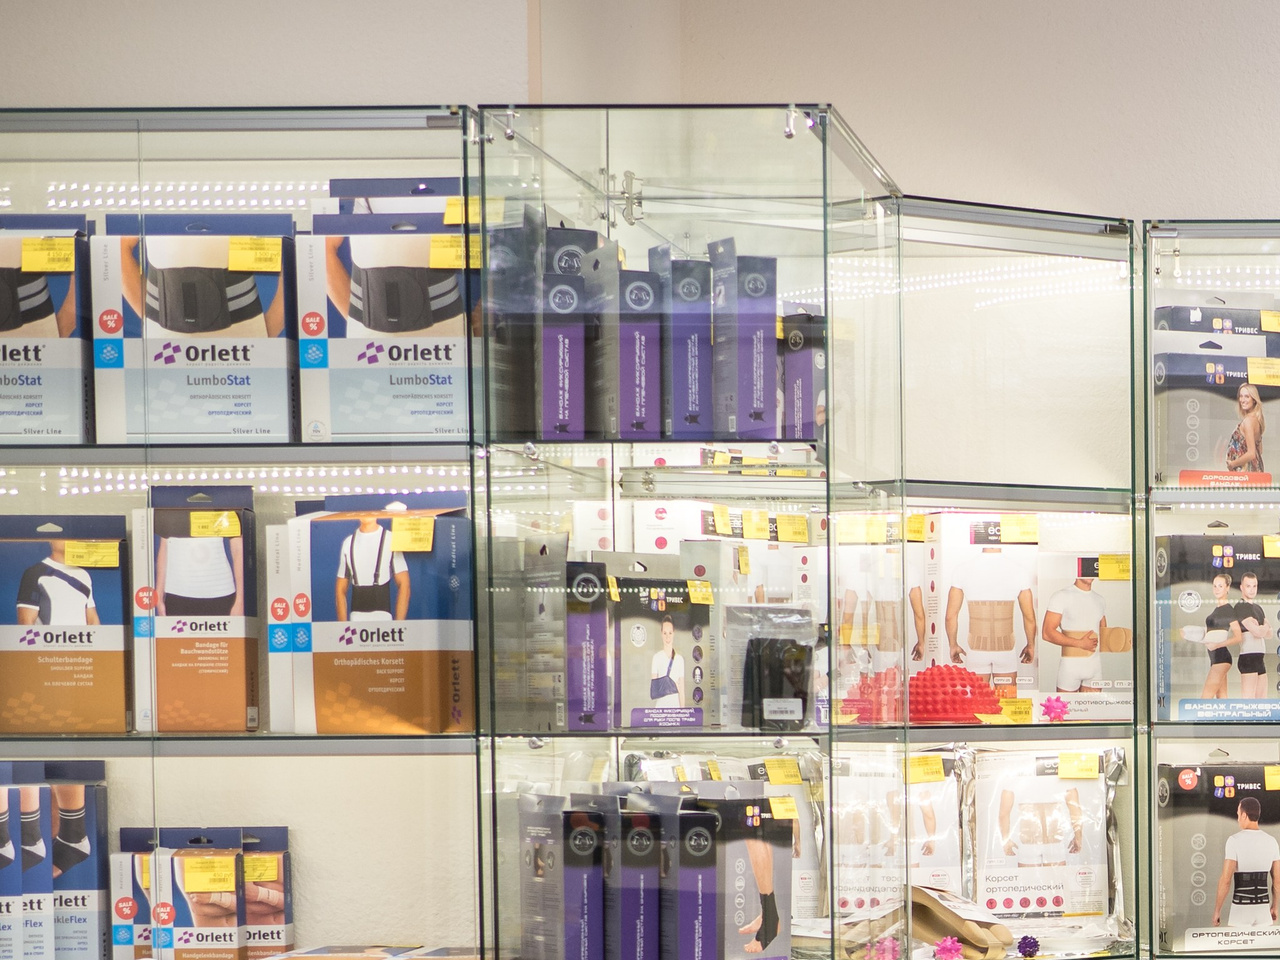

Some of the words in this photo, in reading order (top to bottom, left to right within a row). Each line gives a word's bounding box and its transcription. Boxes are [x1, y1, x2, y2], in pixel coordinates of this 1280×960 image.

[0, 344, 42, 362] lett
[185, 344, 251, 362] Orlett
[388, 344, 453, 361] Orlett
[186, 374, 252, 386] LumboStat
[389, 374, 453, 386] LumboStat
[666, 596, 684, 604] ТРИВЕС
[189, 621, 228, 632] Orlett
[43, 631, 93, 644] Orlett
[359, 627, 405, 643] Orlett
[37, 655, 94, 664] Schulterbandage
[334, 657, 380, 666] Orthopädisches
[381, 657, 405, 665] Korsett
[452, 658, 460, 702] Orlett
[985, 874, 1019, 883] Корсет
[986, 883, 1064, 894] ортопедический
[54, 895, 87, 907] rlett
[196, 932, 234, 943] Orlett
[1191, 929, 1280, 938] ОРТОПЕДИЧЕСКИЙ
